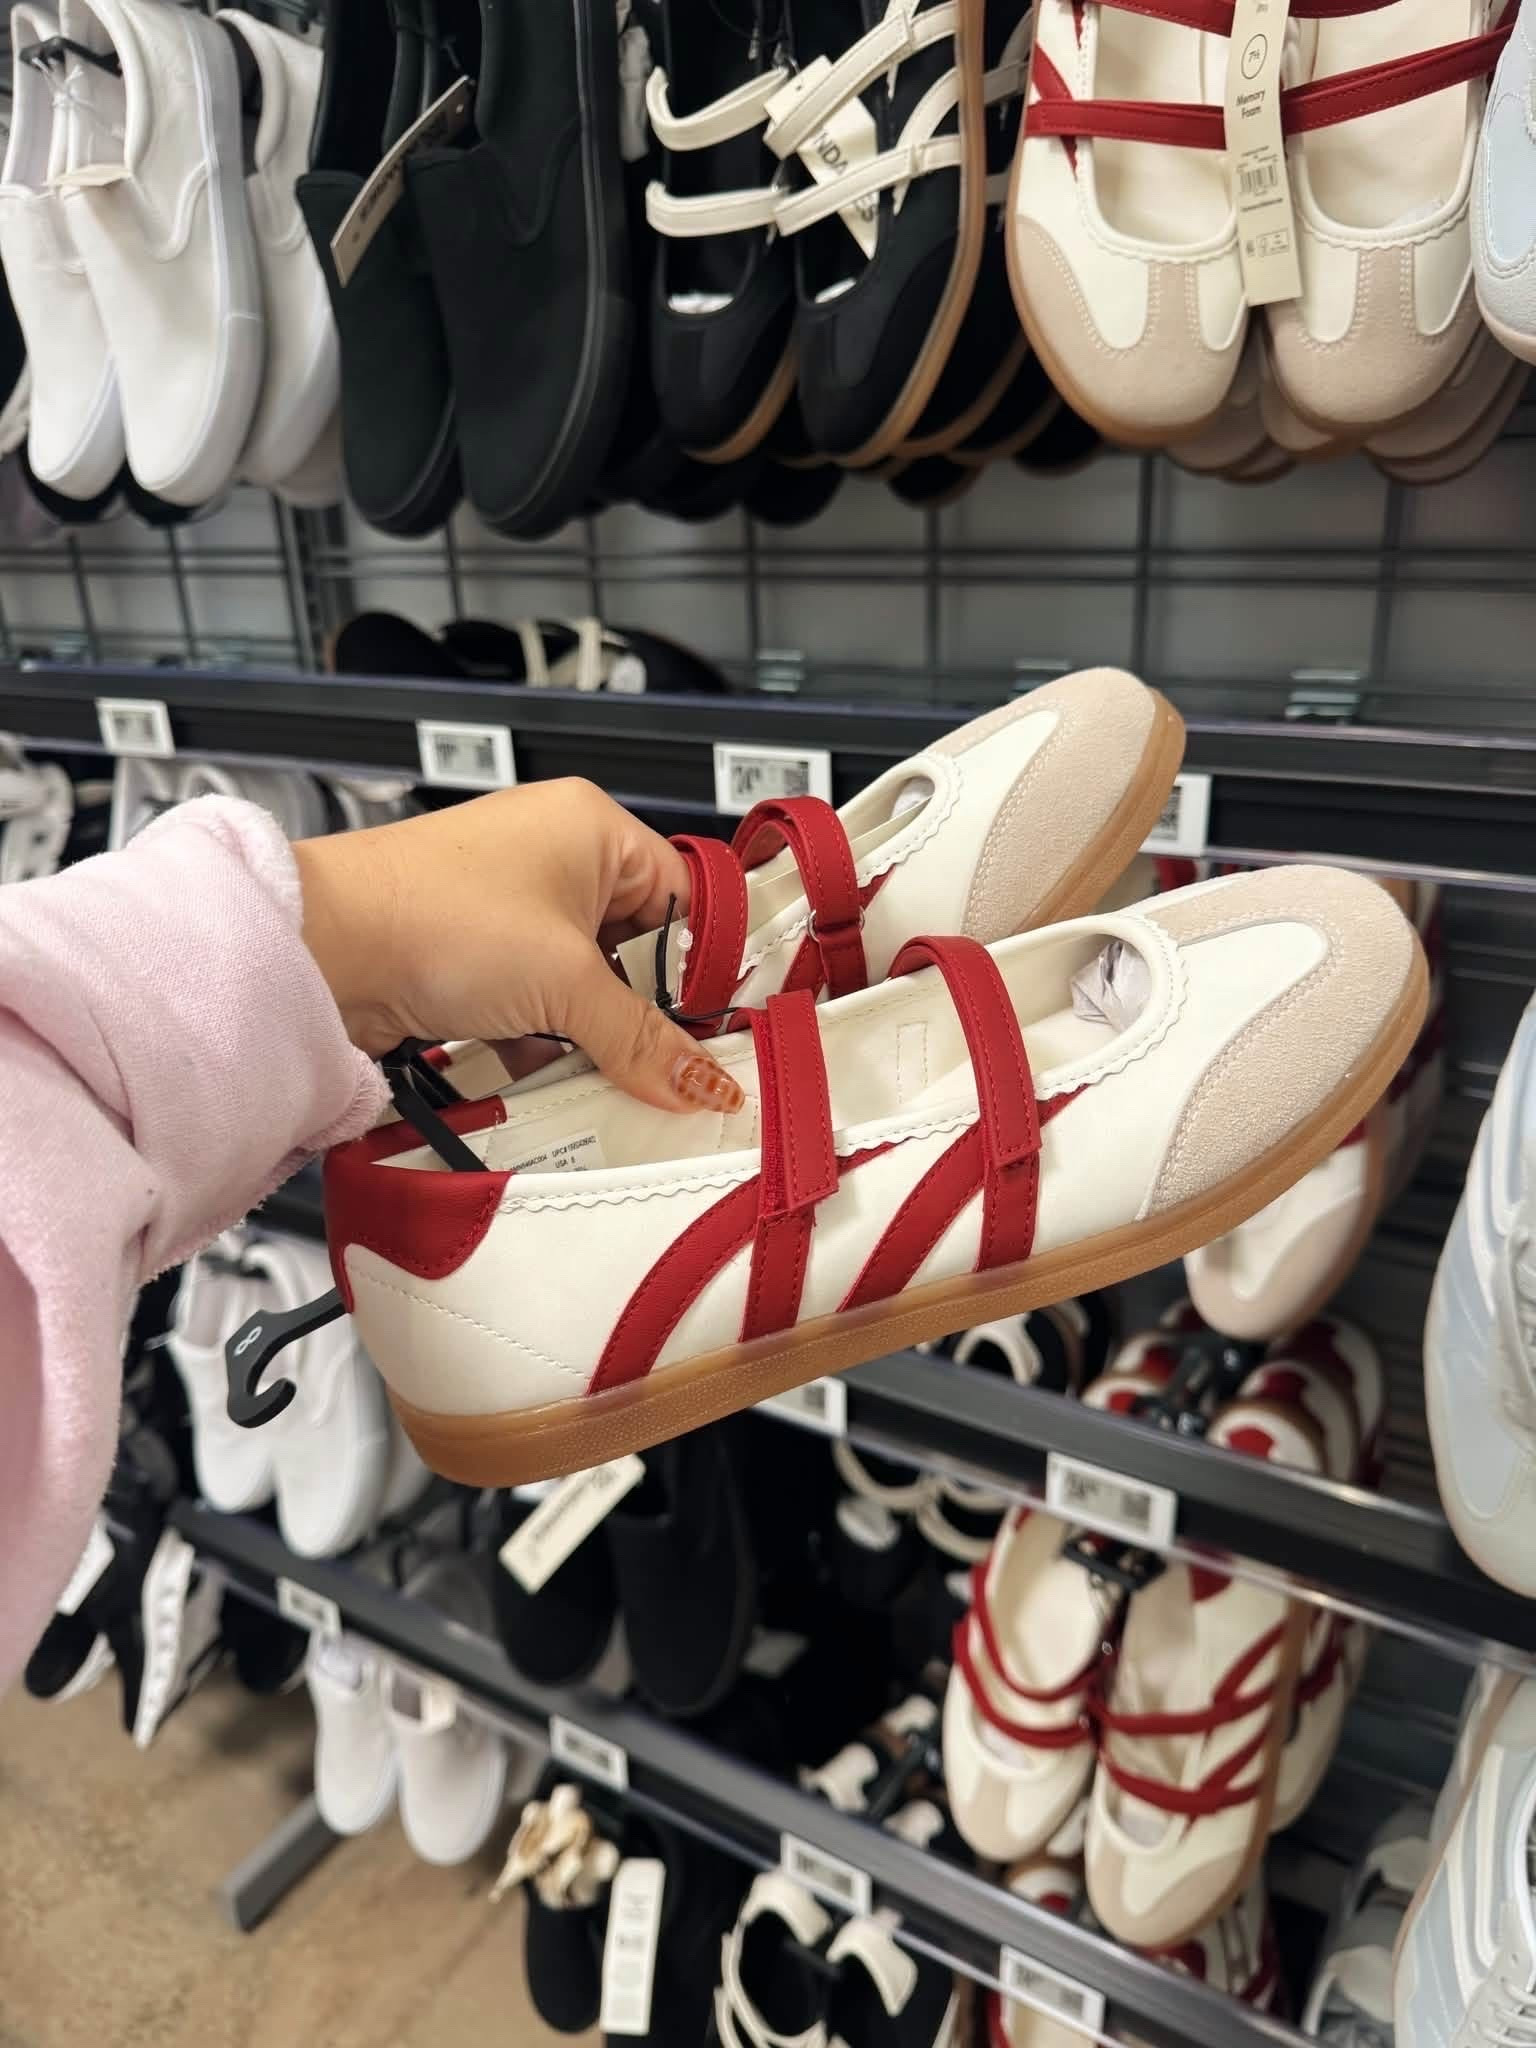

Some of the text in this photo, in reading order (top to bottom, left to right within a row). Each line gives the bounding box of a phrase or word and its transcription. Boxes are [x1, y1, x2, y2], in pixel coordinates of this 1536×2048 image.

[1236, 90, 1265, 106] Memory
[1241, 106, 1262, 119] Foam
[233, 1325, 263, 1357] 8
